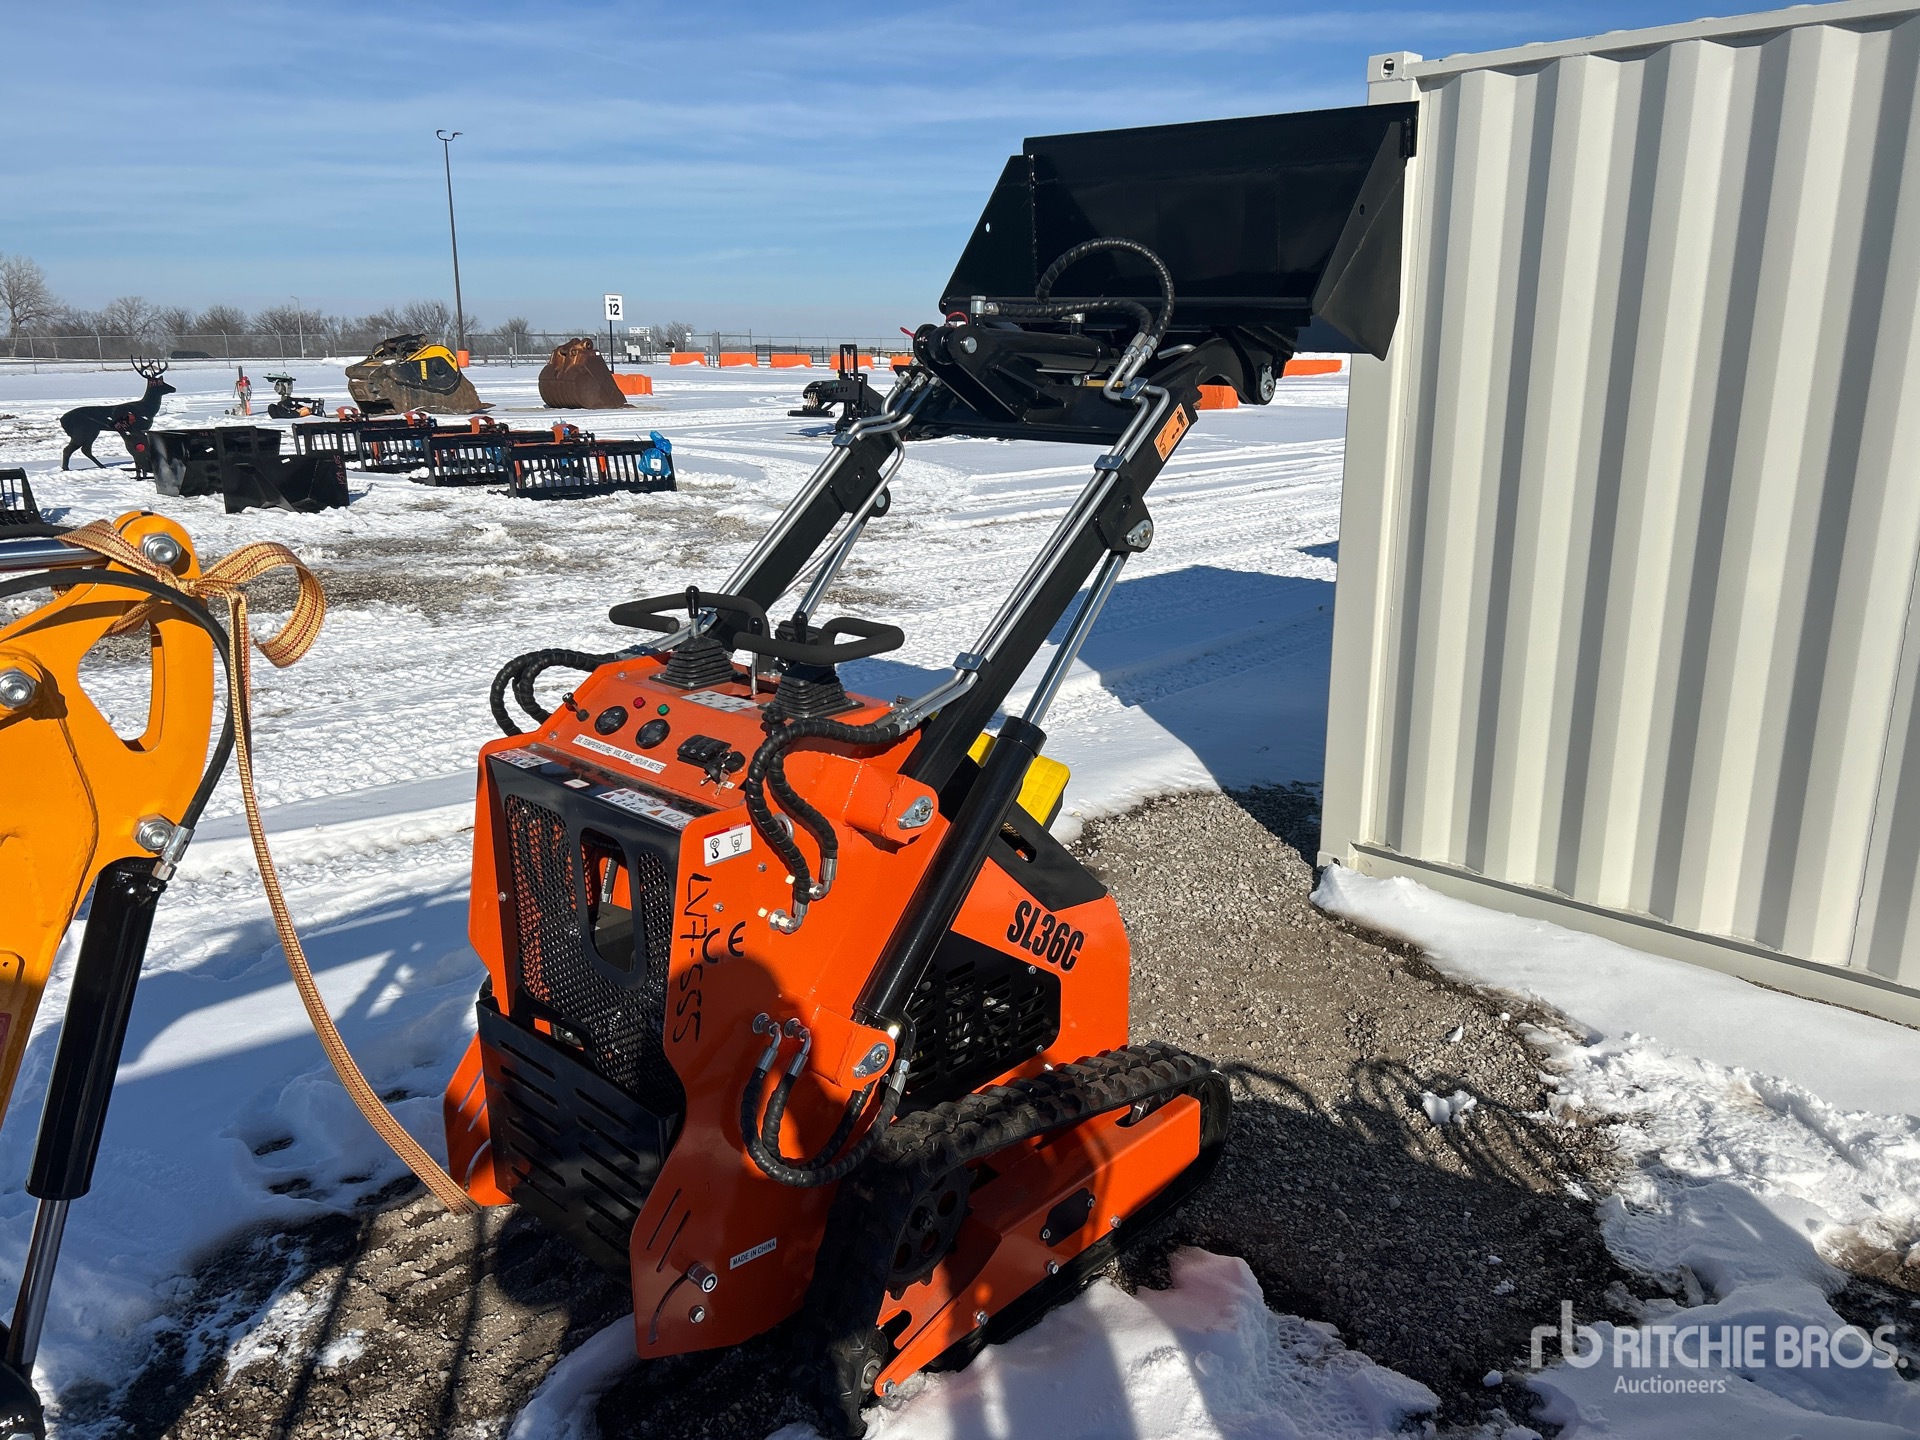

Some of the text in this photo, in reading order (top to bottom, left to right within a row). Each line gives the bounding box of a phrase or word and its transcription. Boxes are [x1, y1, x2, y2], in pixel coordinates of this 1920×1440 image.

[608, 303, 620, 315] 12
[583, 738, 612, 753] TEMPERATURE
[613, 749, 634, 761] VOLTAGE
[635, 757, 648, 766] HOUR
[1007, 900, 1084, 971] SL36C
[733, 1240, 775, 1265] MADE IN CHINA
